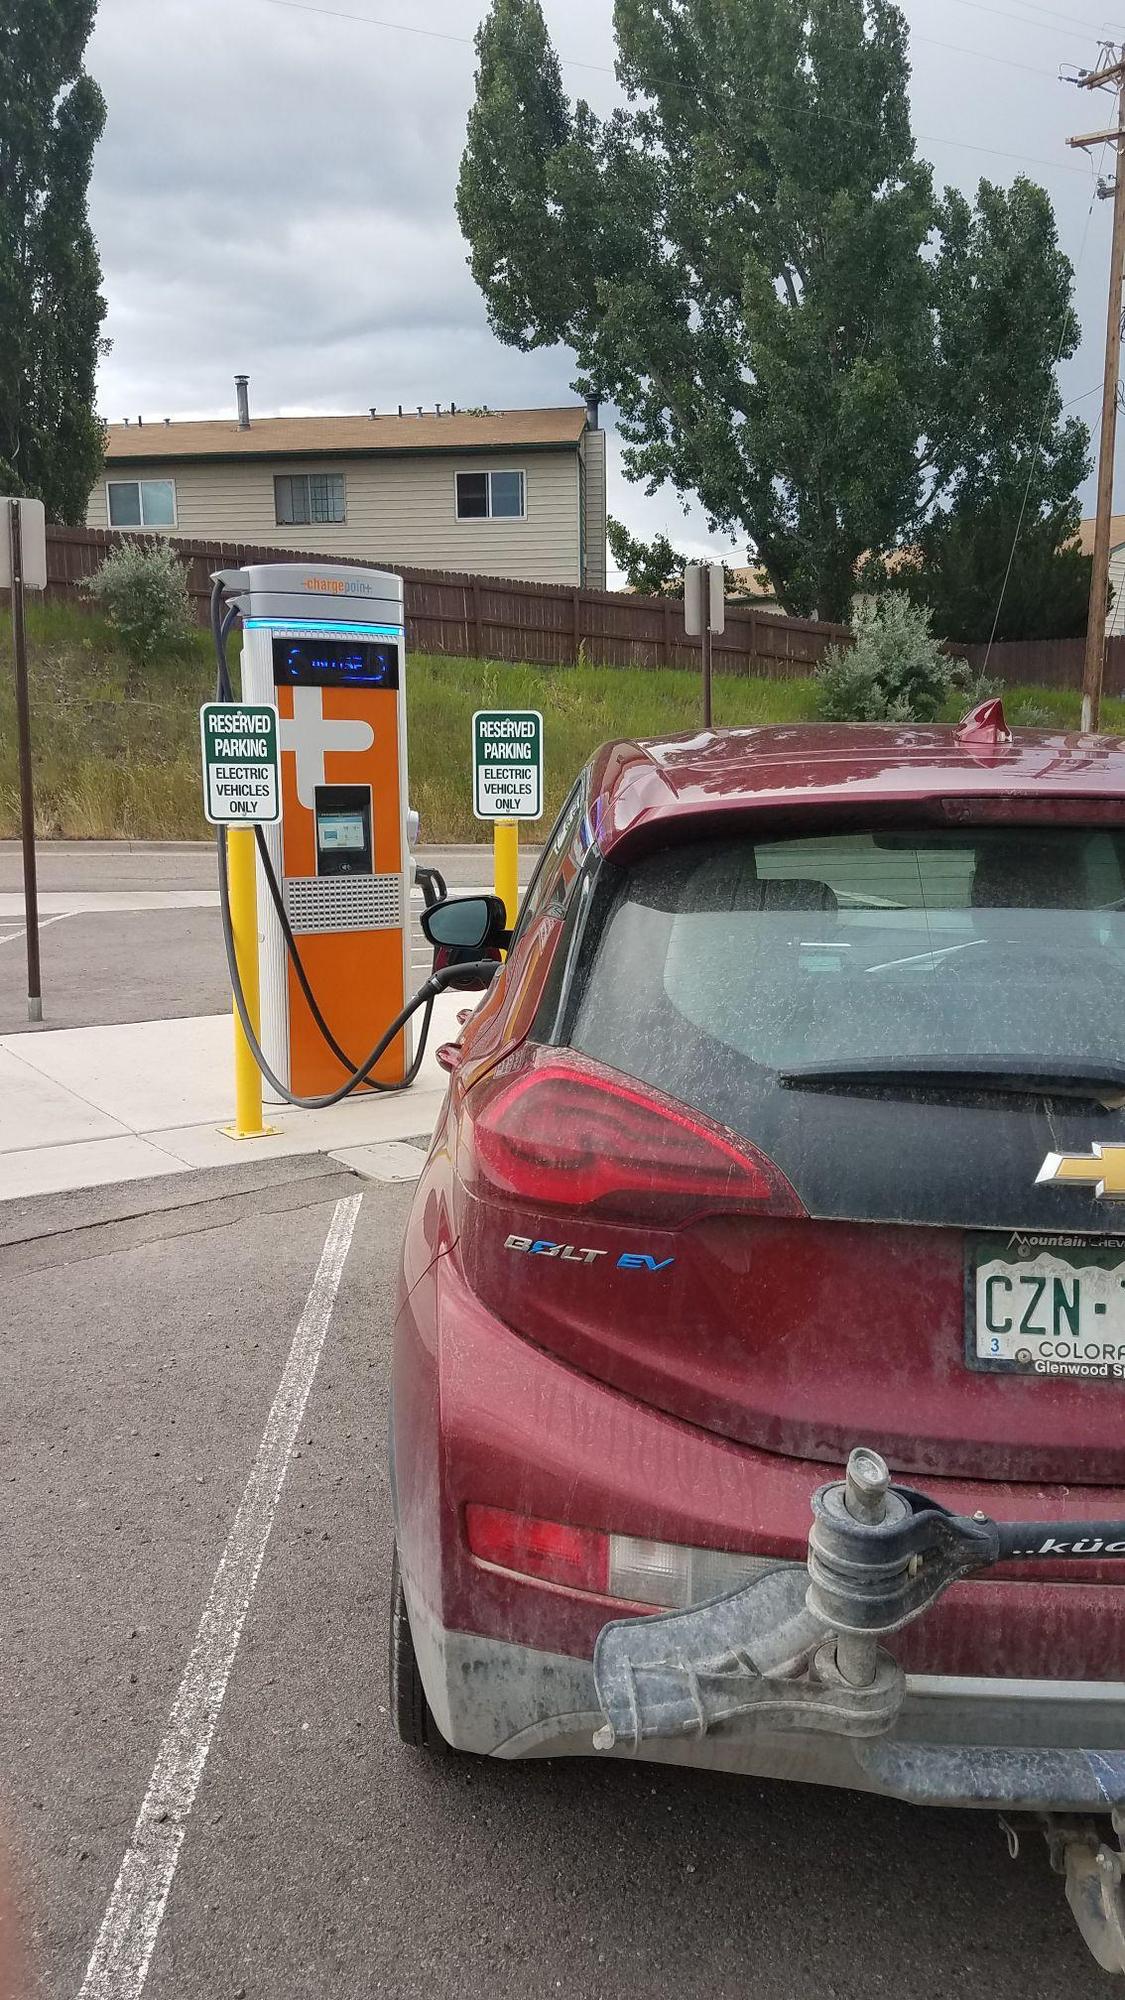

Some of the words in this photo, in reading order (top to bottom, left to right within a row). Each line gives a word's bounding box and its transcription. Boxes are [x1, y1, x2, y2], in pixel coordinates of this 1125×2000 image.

[208, 714, 271, 733] RESERVED
[479, 721, 536, 738] RESERVED
[214, 738, 268, 758] PARKING
[484, 742, 531, 759] PARKING
[216, 767, 269, 780] ELECTRIC
[484, 768, 532, 780] ELECTRIC
[216, 783, 270, 797] VEHICLES
[484, 783, 532, 795] VEHICLES
[229, 800, 258, 813] ONLY
[495, 798, 521, 810] ONLY
[1006, 1231, 1086, 1250] Mountain
[503, 1234, 608, 1263] BOLT
[616, 1252, 675, 1271] EV
[990, 1337, 1000, 1352] 3
[1034, 1360, 1108, 1376] Glenwood
[1112, 1363, 1125, 1379] S
